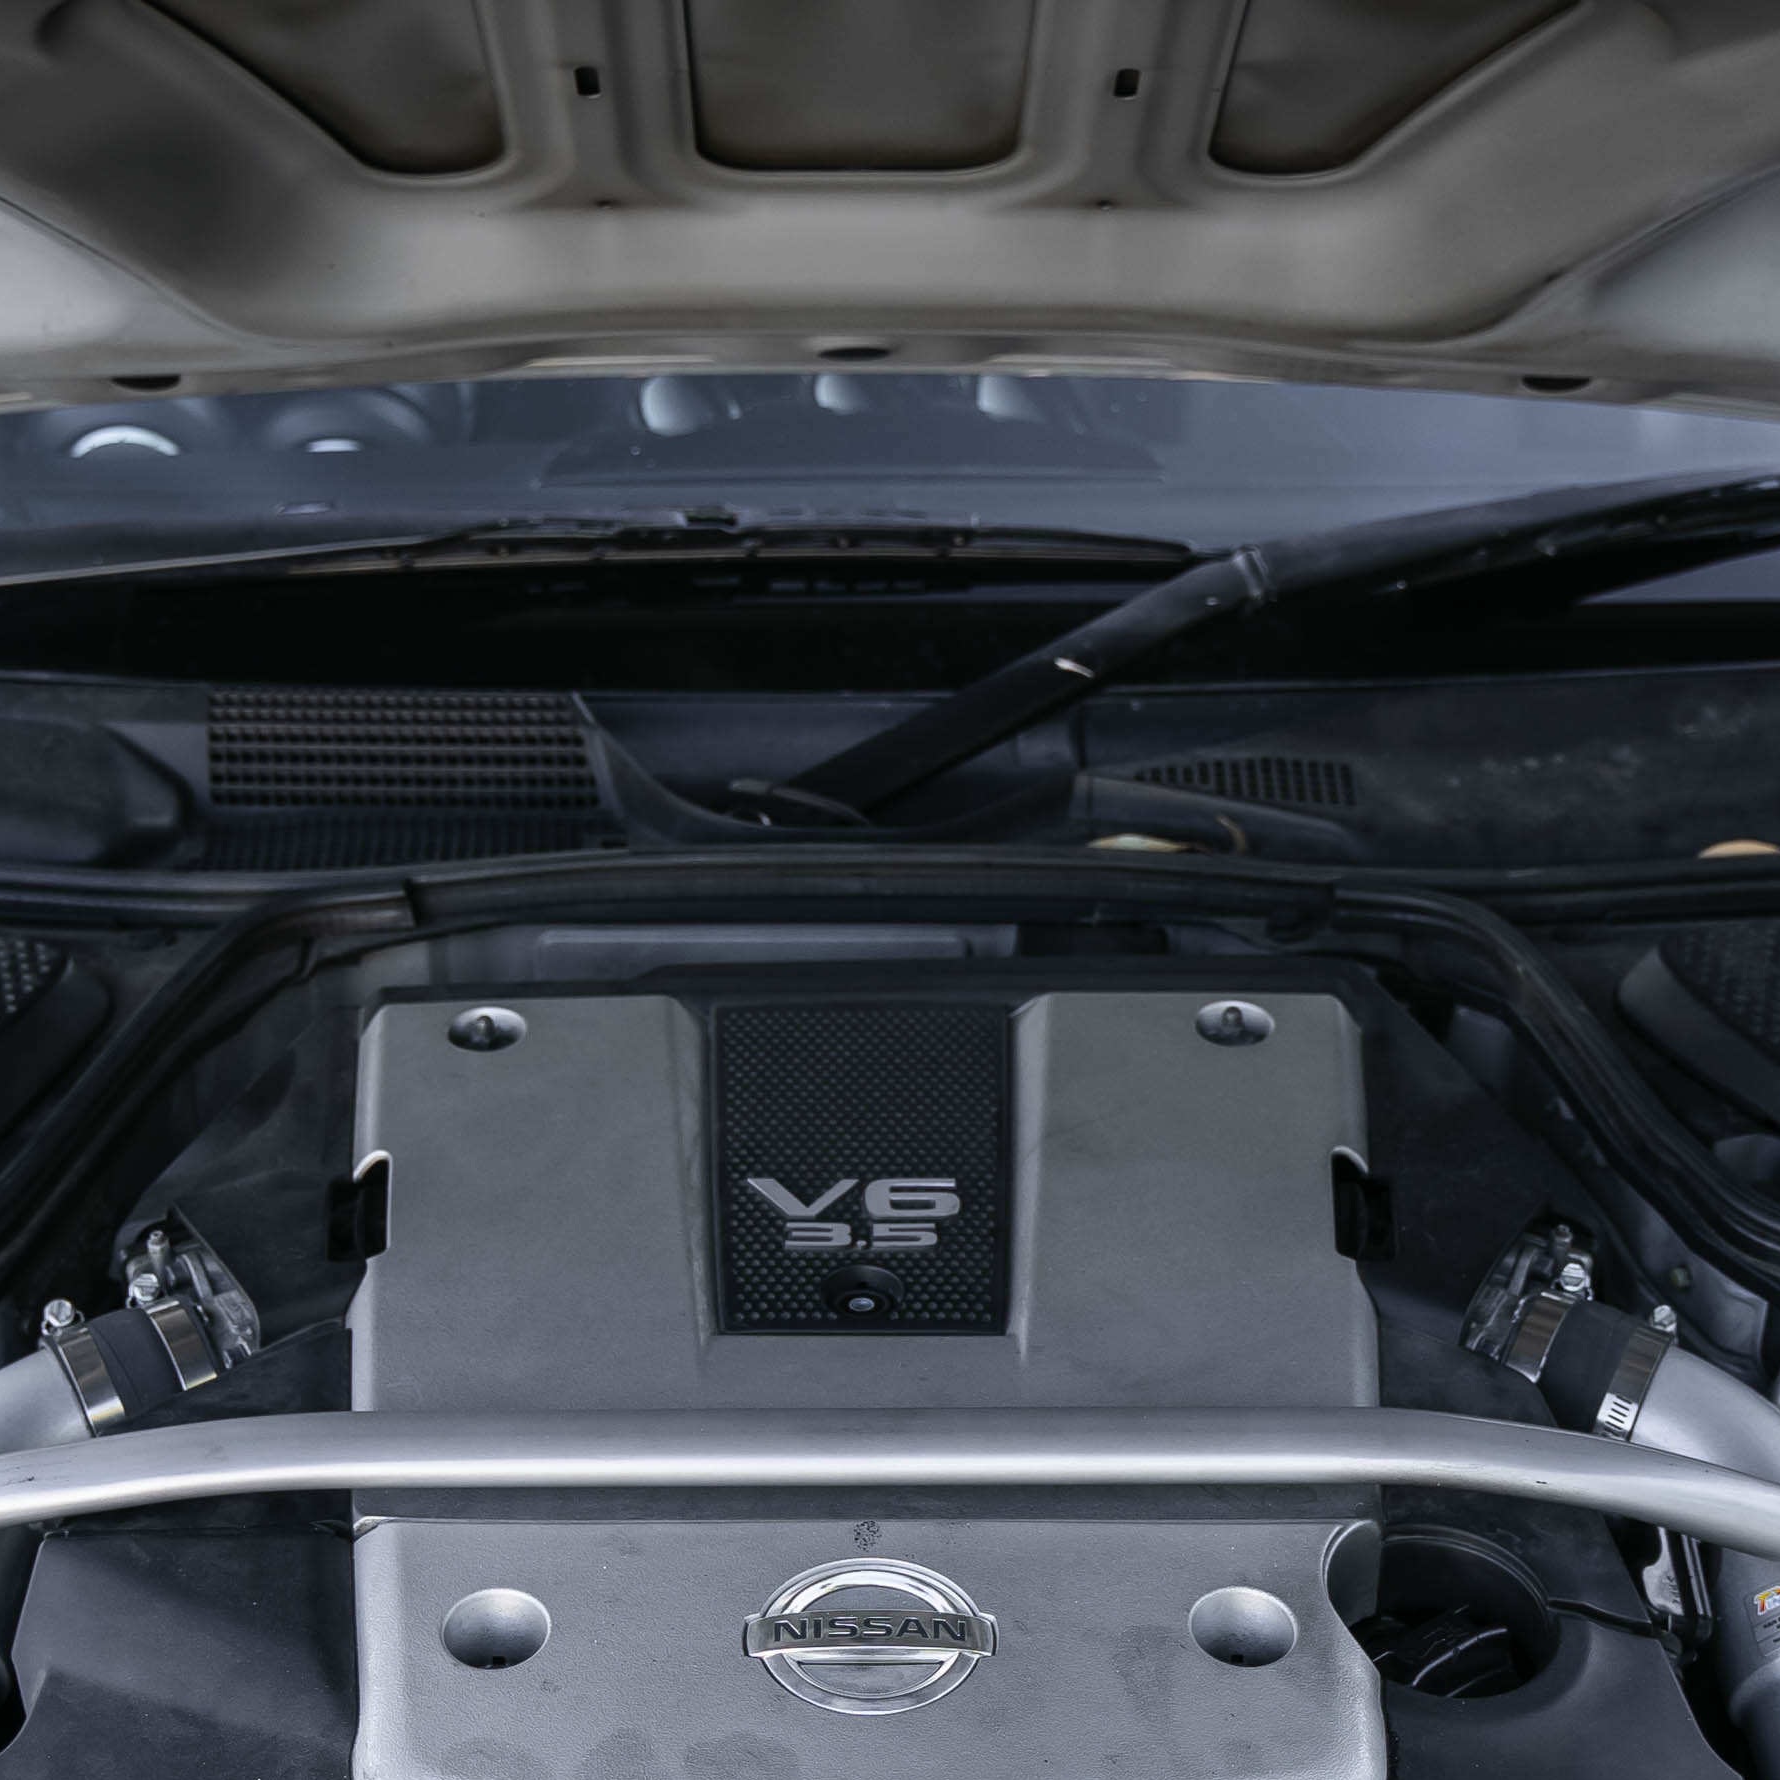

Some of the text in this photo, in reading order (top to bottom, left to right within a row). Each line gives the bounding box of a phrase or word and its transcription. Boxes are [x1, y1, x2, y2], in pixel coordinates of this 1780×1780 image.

[746, 1177, 960, 1218] V6
[783, 1221, 939, 1250] 3.5
[771, 1615, 969, 1645] NISSAN
